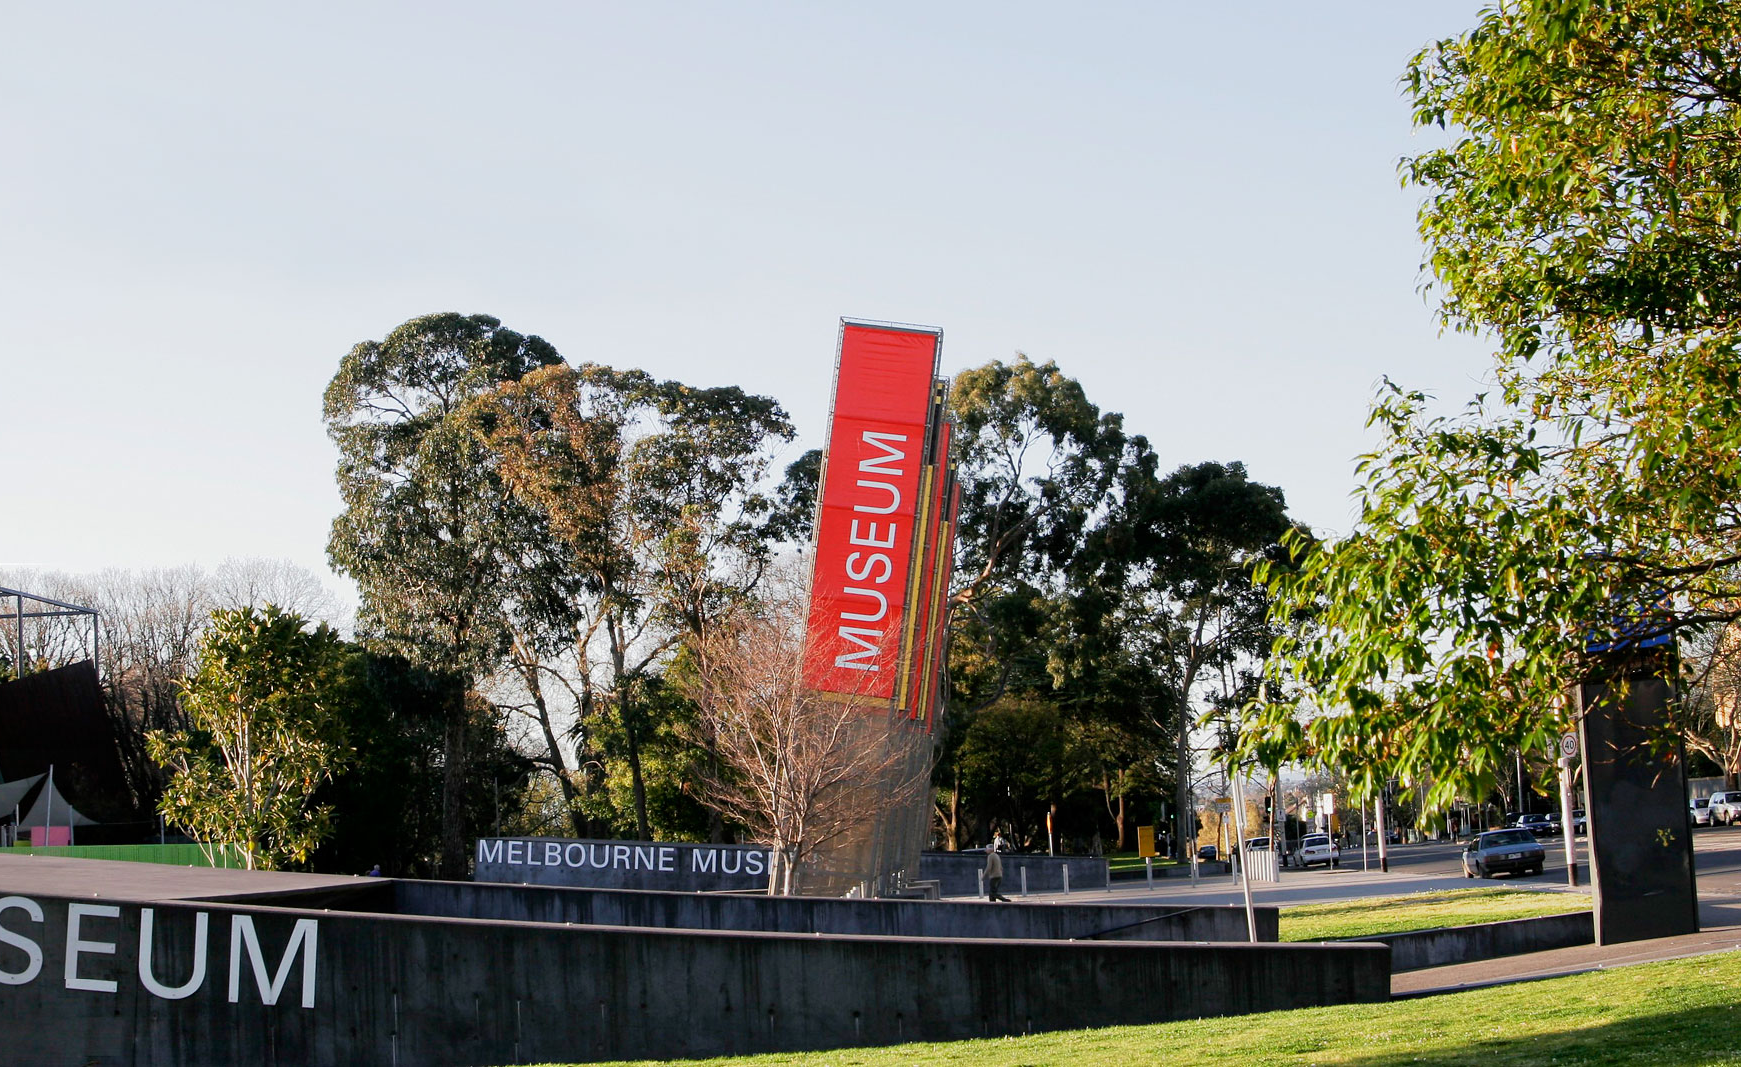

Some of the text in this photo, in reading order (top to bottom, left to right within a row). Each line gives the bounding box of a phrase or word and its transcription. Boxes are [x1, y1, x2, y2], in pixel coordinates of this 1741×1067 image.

[834, 430, 908, 672] MUSEUM
[1565, 740, 1574, 750] 40
[478, 839, 675, 872] MELBOURNE
